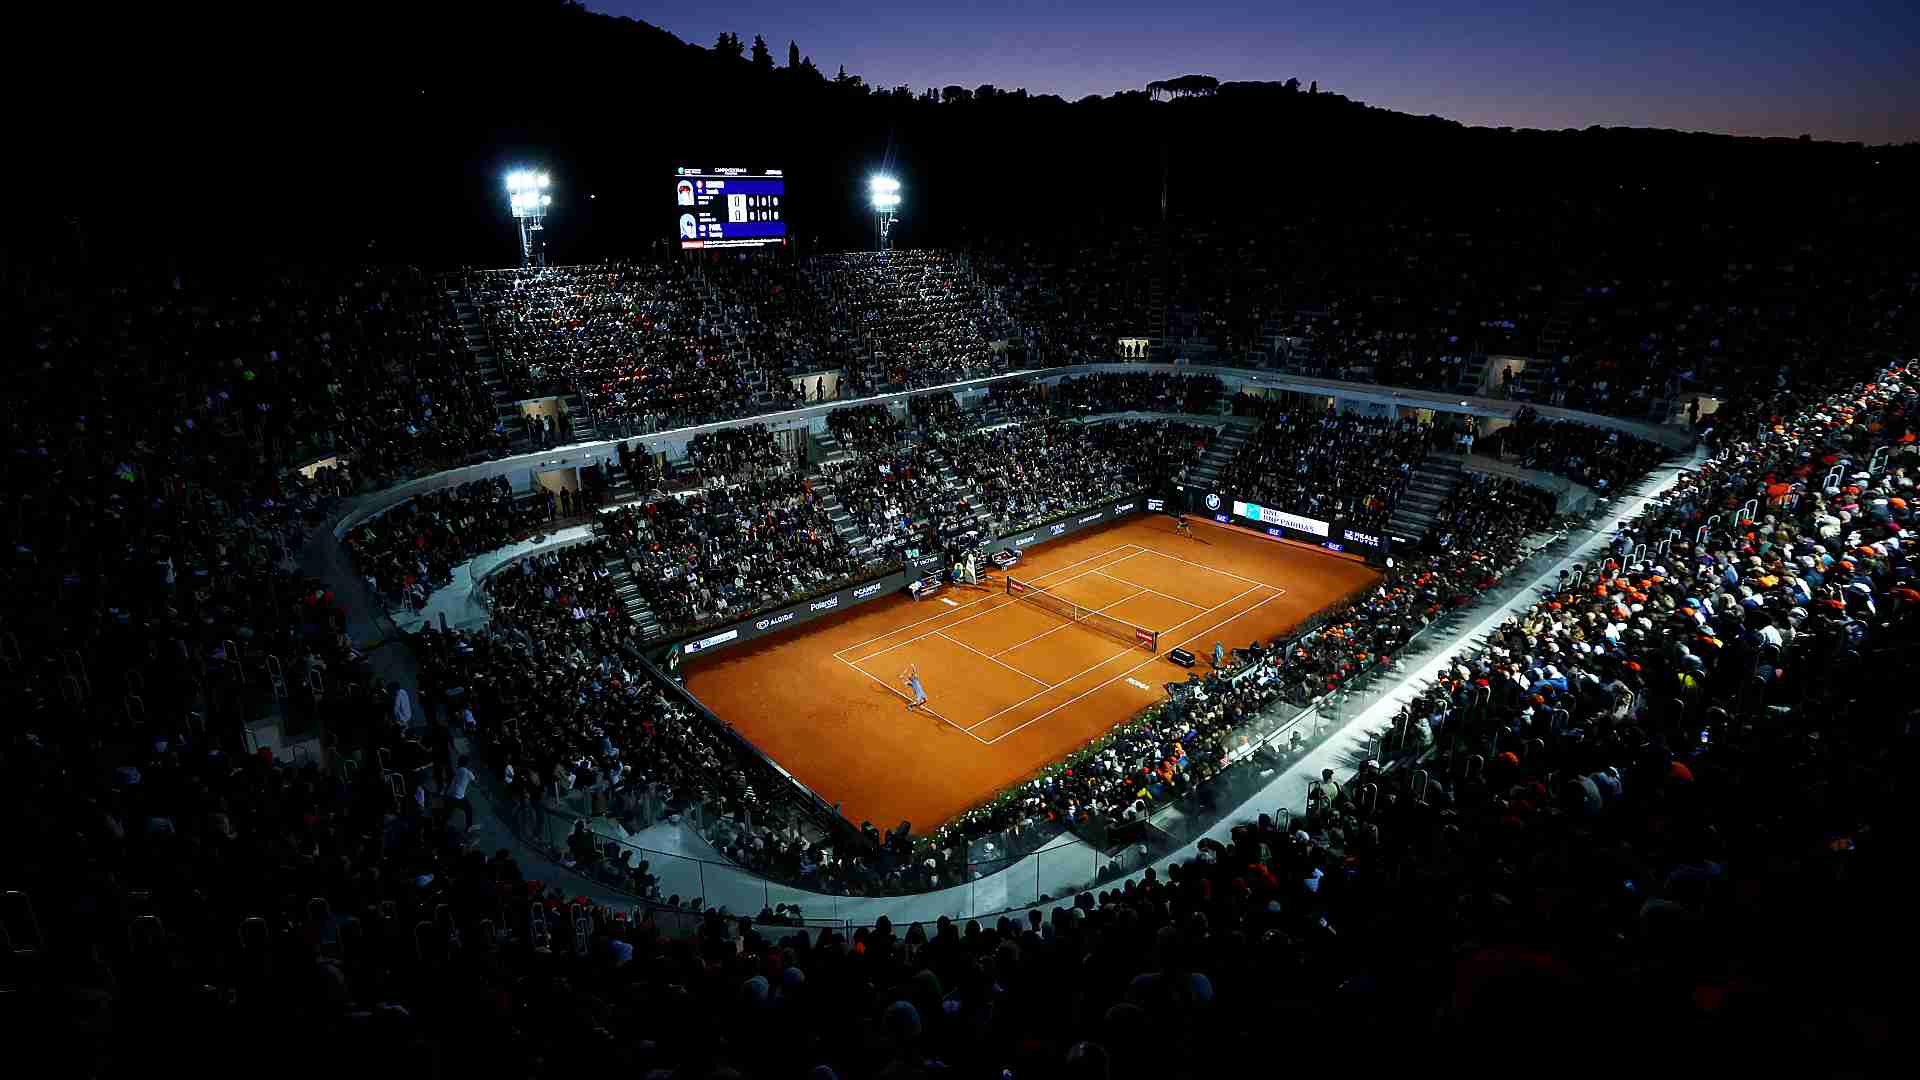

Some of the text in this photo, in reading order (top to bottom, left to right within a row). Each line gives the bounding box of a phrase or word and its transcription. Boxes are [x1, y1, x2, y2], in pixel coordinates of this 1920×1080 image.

[1263, 514, 1314, 532] BNP PARIBAS
[810, 596, 838, 611] Polaroid
